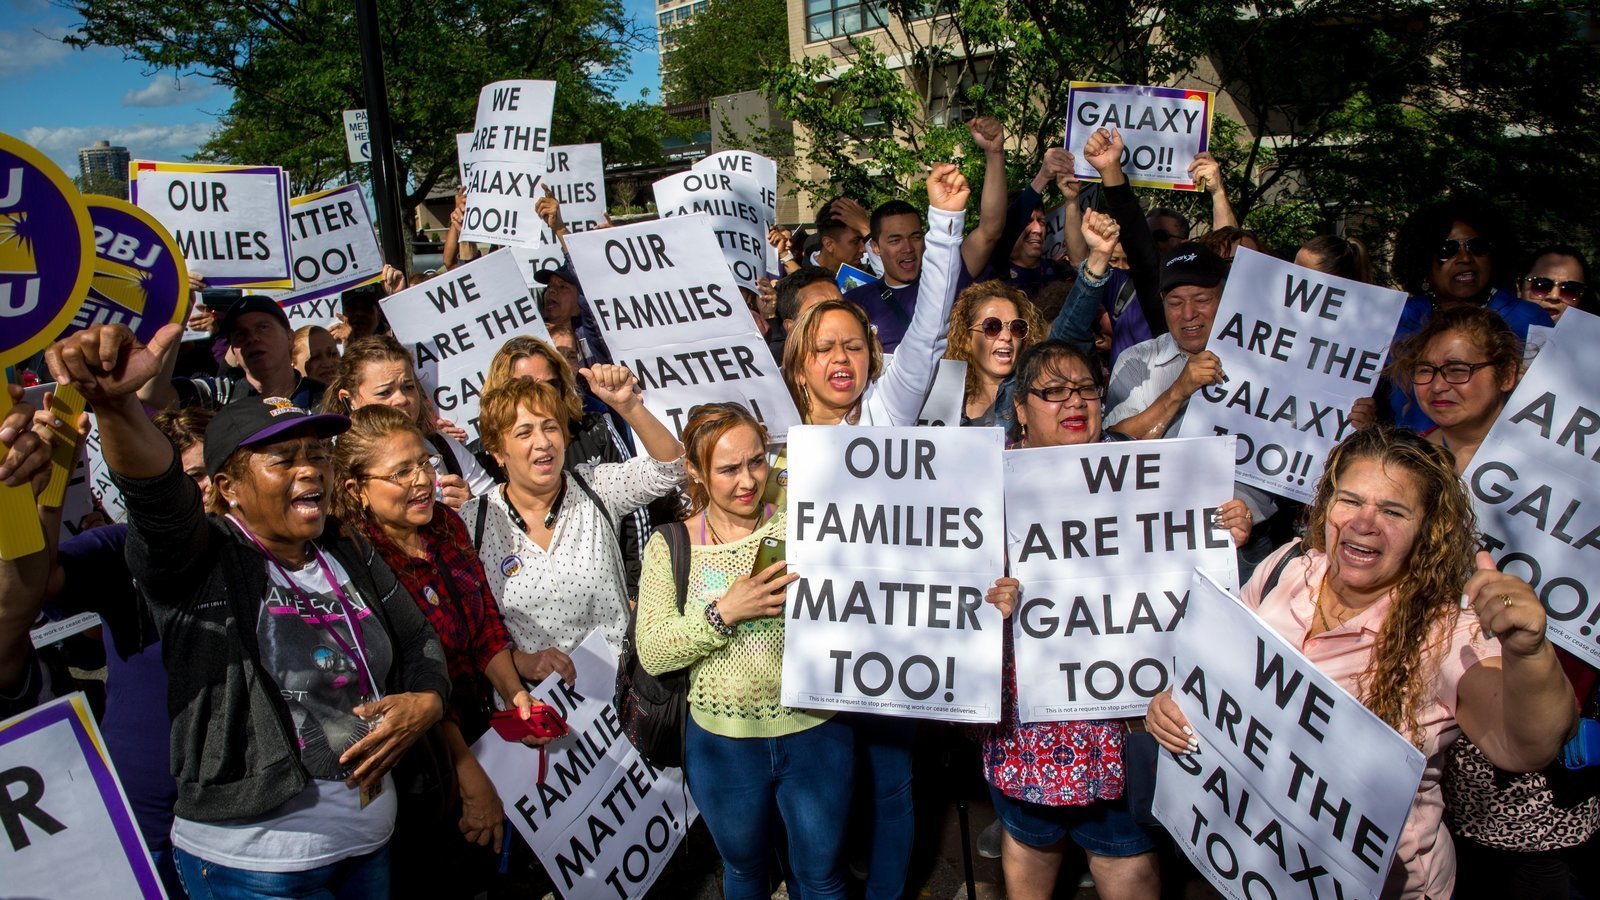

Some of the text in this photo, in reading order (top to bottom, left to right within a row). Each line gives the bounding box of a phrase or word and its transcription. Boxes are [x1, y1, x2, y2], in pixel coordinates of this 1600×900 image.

[355, 111, 368, 121] PA
[492, 87, 521, 112] WE
[1077, 101, 1200, 134] GALAXY
[349, 122, 369, 131] MET
[354, 132, 370, 141] HE
[470, 126, 547, 153] ARE THE
[684, 174, 733, 191] OUR
[718, 155, 752, 173] WE
[168, 180, 229, 212] OUR
[290, 201, 358, 241] TTER
[464, 206, 518, 235] TOO!!
[94, 225, 163, 268] 2BJ
[177, 230, 270, 260] MILIES
[294, 244, 358, 282] OO!
[604, 234, 675, 275] OUR
[714, 230, 762, 260] TTER
[288, 299, 338, 318] AXY
[425, 273, 481, 315] WE
[594, 283, 733, 332] FAMILIES
[1283, 273, 1346, 321] WE
[415, 296, 537, 369] ARE THE
[1216, 312, 1381, 385] ARE THE
[620, 345, 765, 390] MATTER
[1201, 375, 1353, 442] GALAXY
[1509, 391, 1600, 464] AR
[844, 436, 937, 481] OUR
[1079, 453, 1161, 494] WE
[796, 501, 984, 550] FAMILIES
[1018, 506, 1229, 563] ARE THE
[791, 577, 982, 631] MATTER
[1020, 589, 1191, 640] GALAX
[1548, 625, 1564, 637] work
[1572, 638, 1590, 651] cease
[829, 649, 956, 703] TOO!
[1059, 655, 1175, 702] TOO
[1254, 635, 1335, 744] WE
[540, 678, 585, 722] UR
[880, 702, 911, 710] performing
[949, 706, 977, 715] deliveries.
[1120, 703, 1148, 711] performin
[515, 704, 622, 833] FAMILIE
[1181, 665, 1390, 874] ARE THE
[605, 800, 679, 900] TOO!
